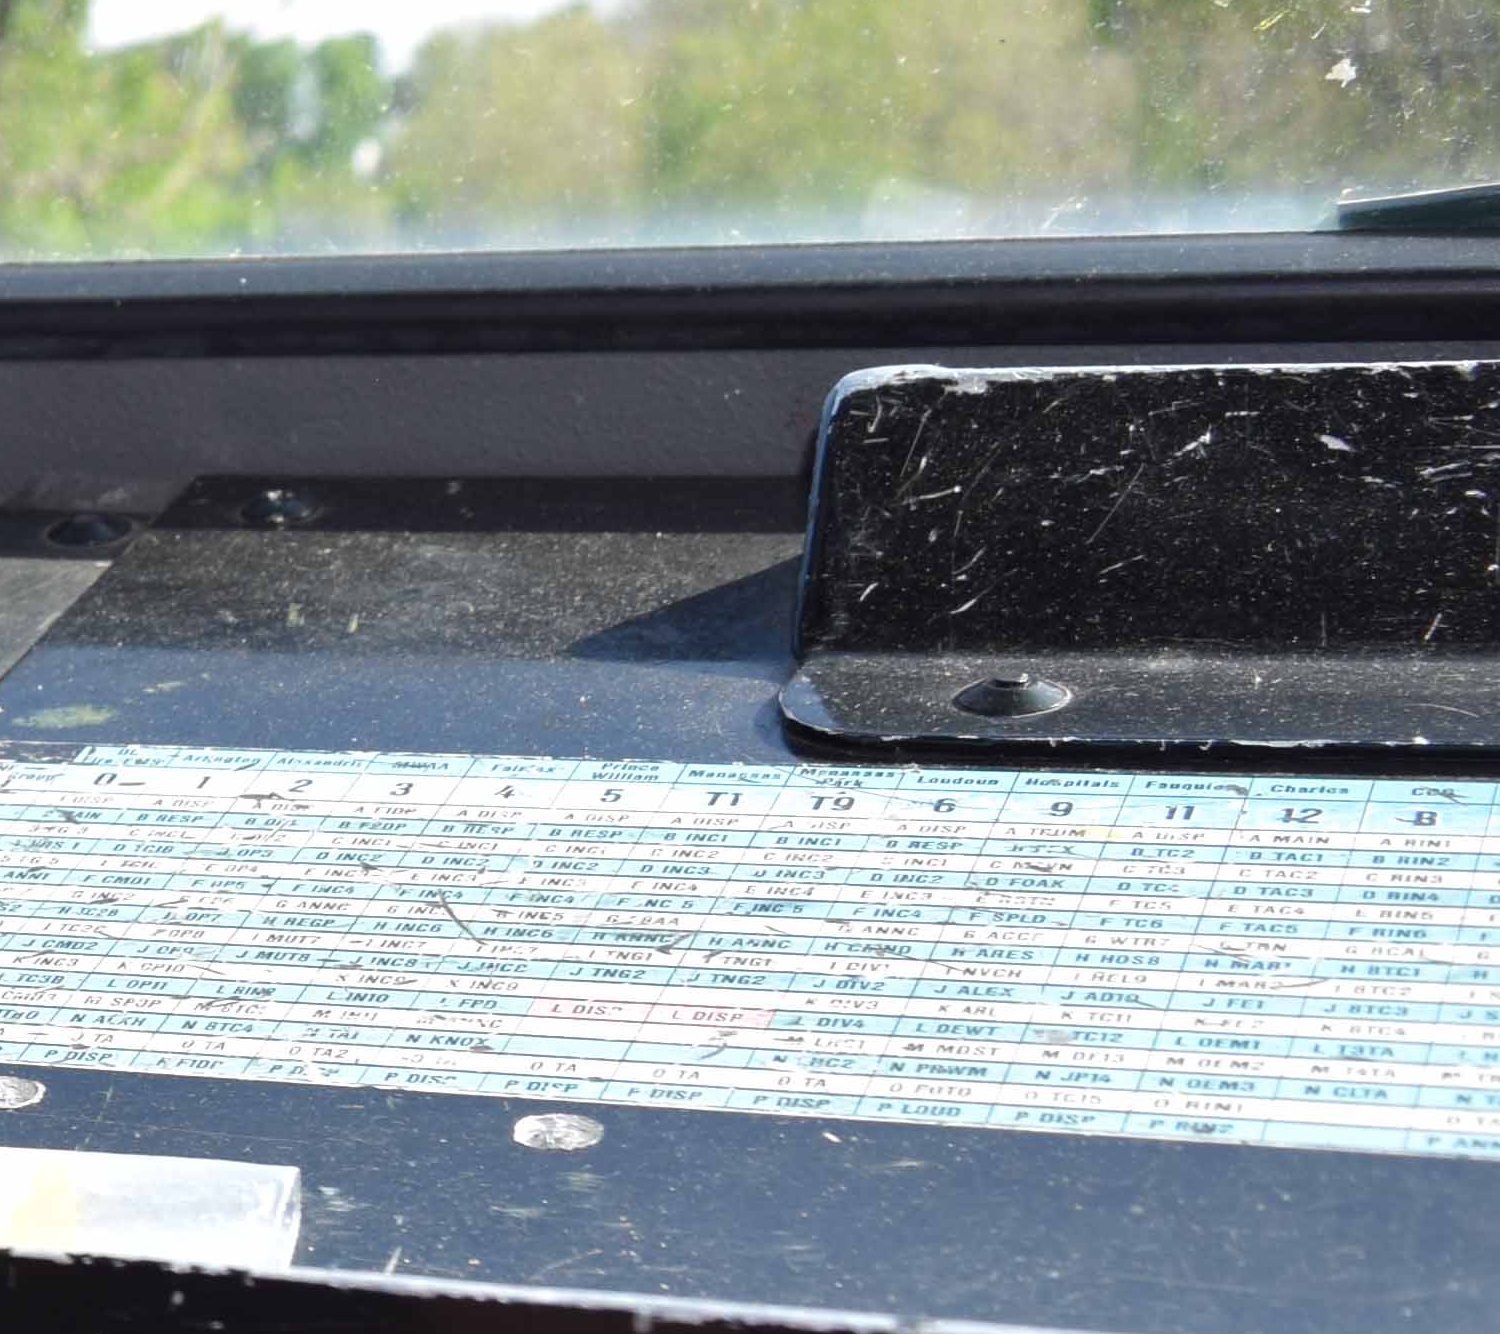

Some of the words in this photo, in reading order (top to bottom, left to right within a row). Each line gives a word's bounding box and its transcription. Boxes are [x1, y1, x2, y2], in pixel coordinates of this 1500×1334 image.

[288, 778, 313, 793] 2
[389, 782, 414, 796] 3
[599, 788, 625, 803] 5
[932, 798, 957, 813] 6
[1049, 801, 1074, 817] 9
